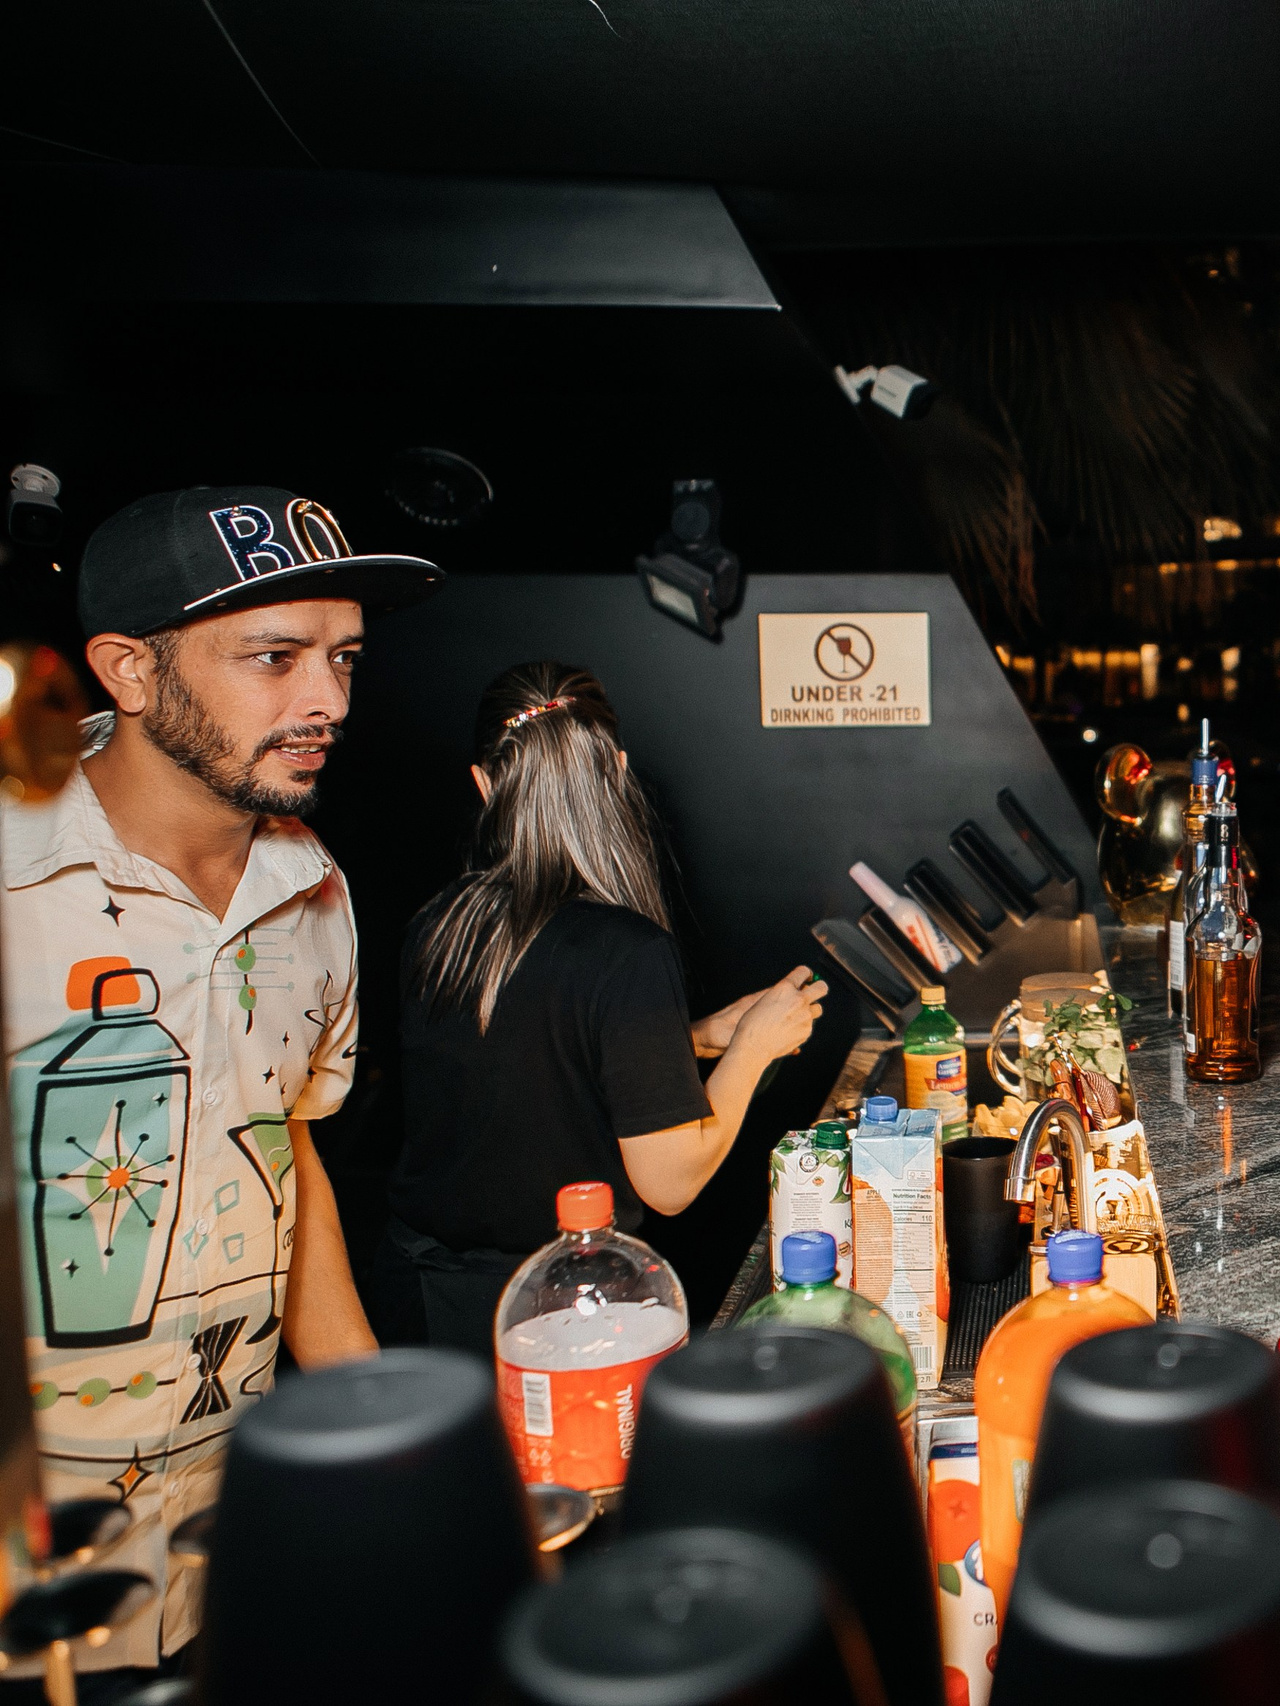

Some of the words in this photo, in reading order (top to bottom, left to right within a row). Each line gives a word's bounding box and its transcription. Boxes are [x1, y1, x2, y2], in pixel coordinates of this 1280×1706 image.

[791, 685, 862, 703] UNDER
[869, 685, 898, 701] -21
[770, 707, 834, 722] DIRNKING
[842, 706, 921, 722] PROHIBITED
[616, 1383, 635, 1460] ORIGINAL
[974, 1612, 998, 1627] CR
